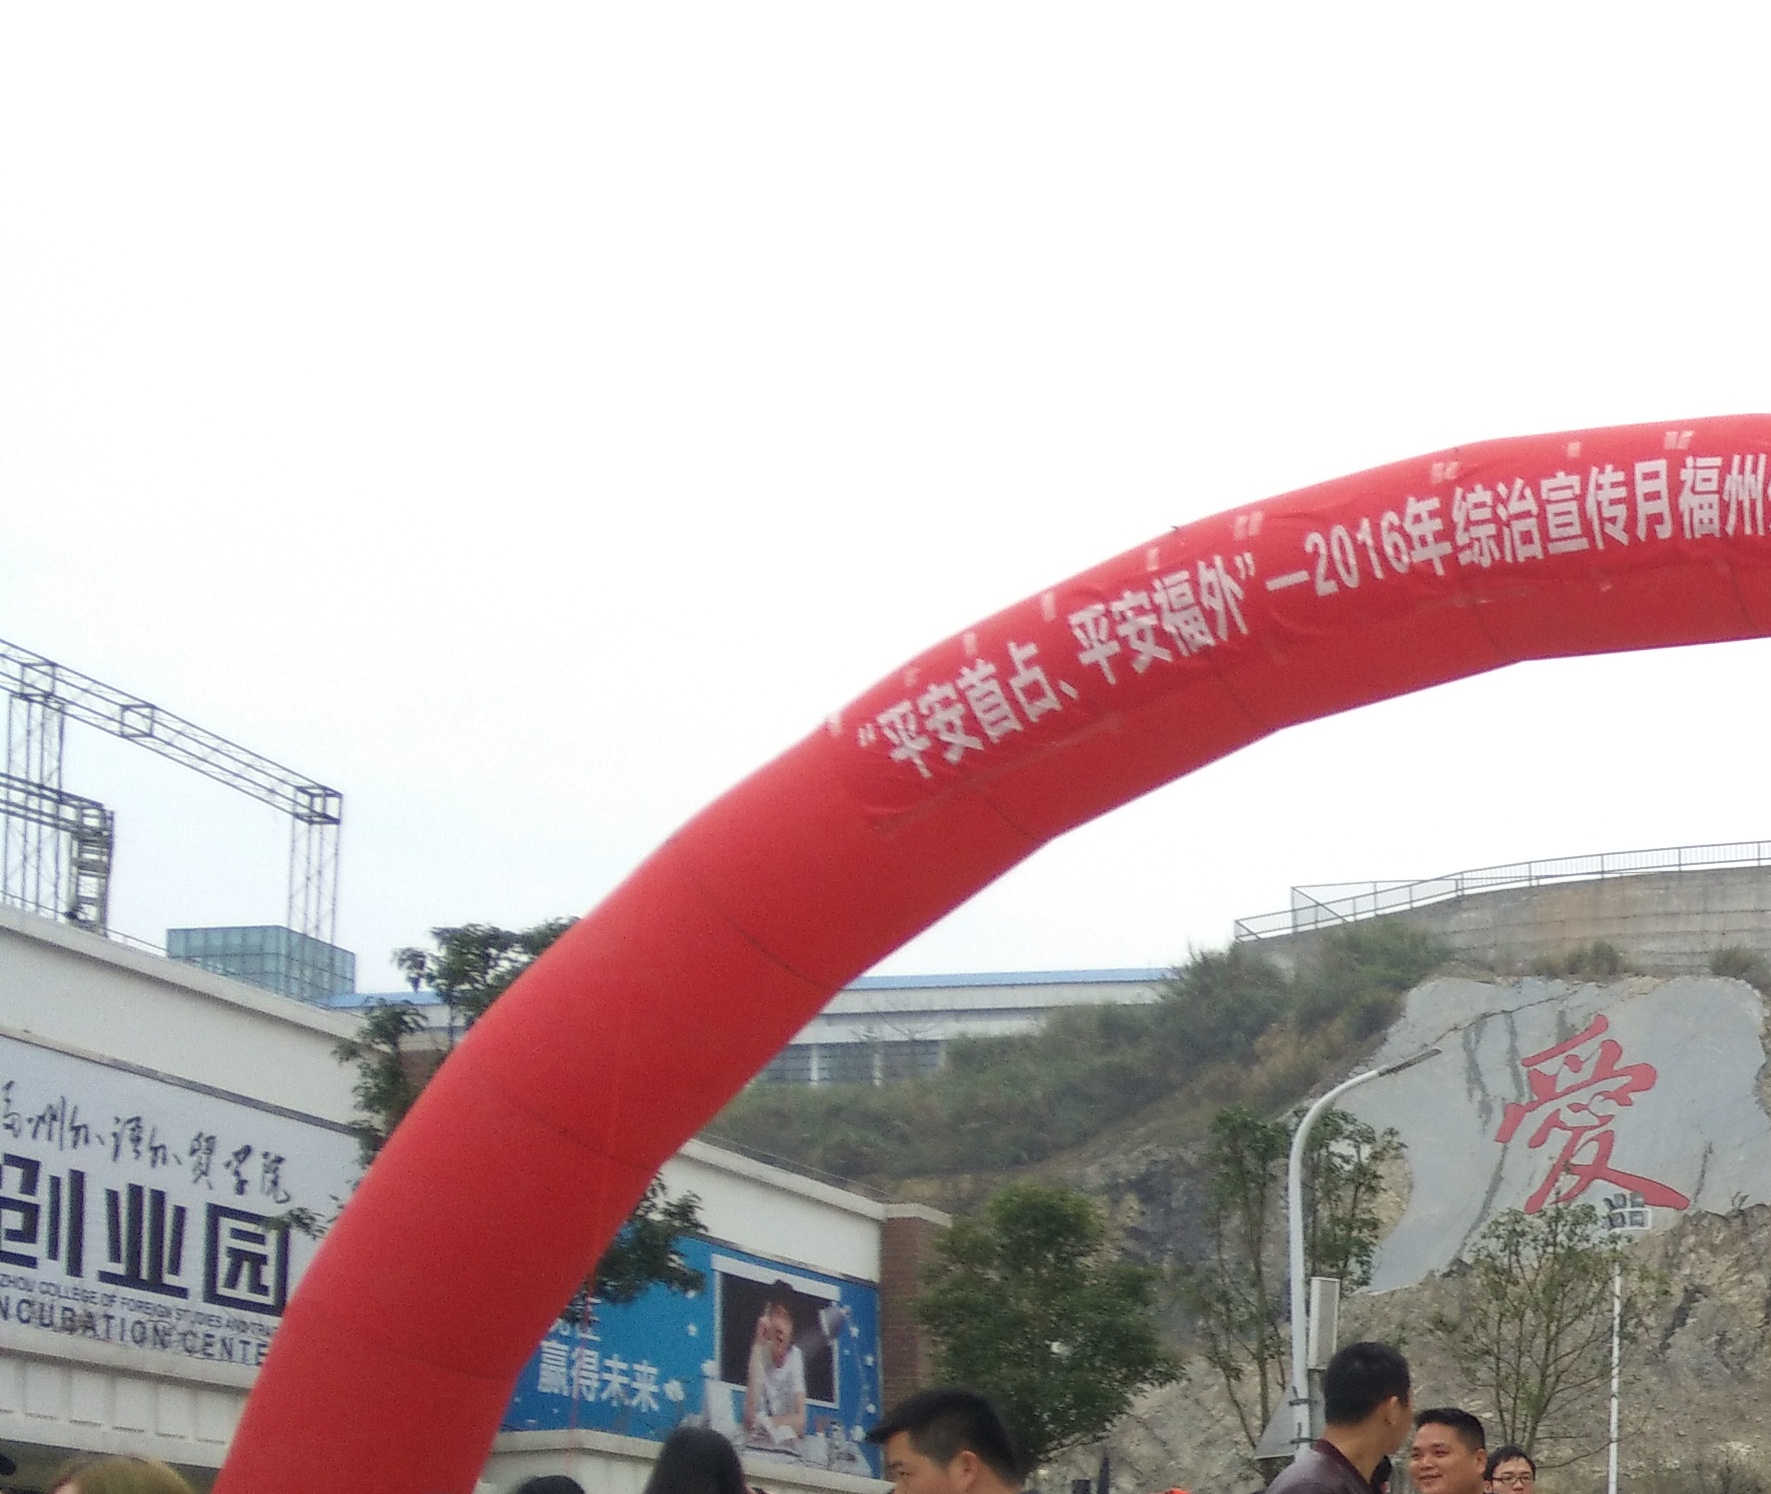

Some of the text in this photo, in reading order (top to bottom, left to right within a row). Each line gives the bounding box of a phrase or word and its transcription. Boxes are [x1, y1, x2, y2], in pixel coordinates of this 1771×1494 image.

[0, 1152, 289, 1317] 创业园
[178, 1328, 269, 1366] CENTE
